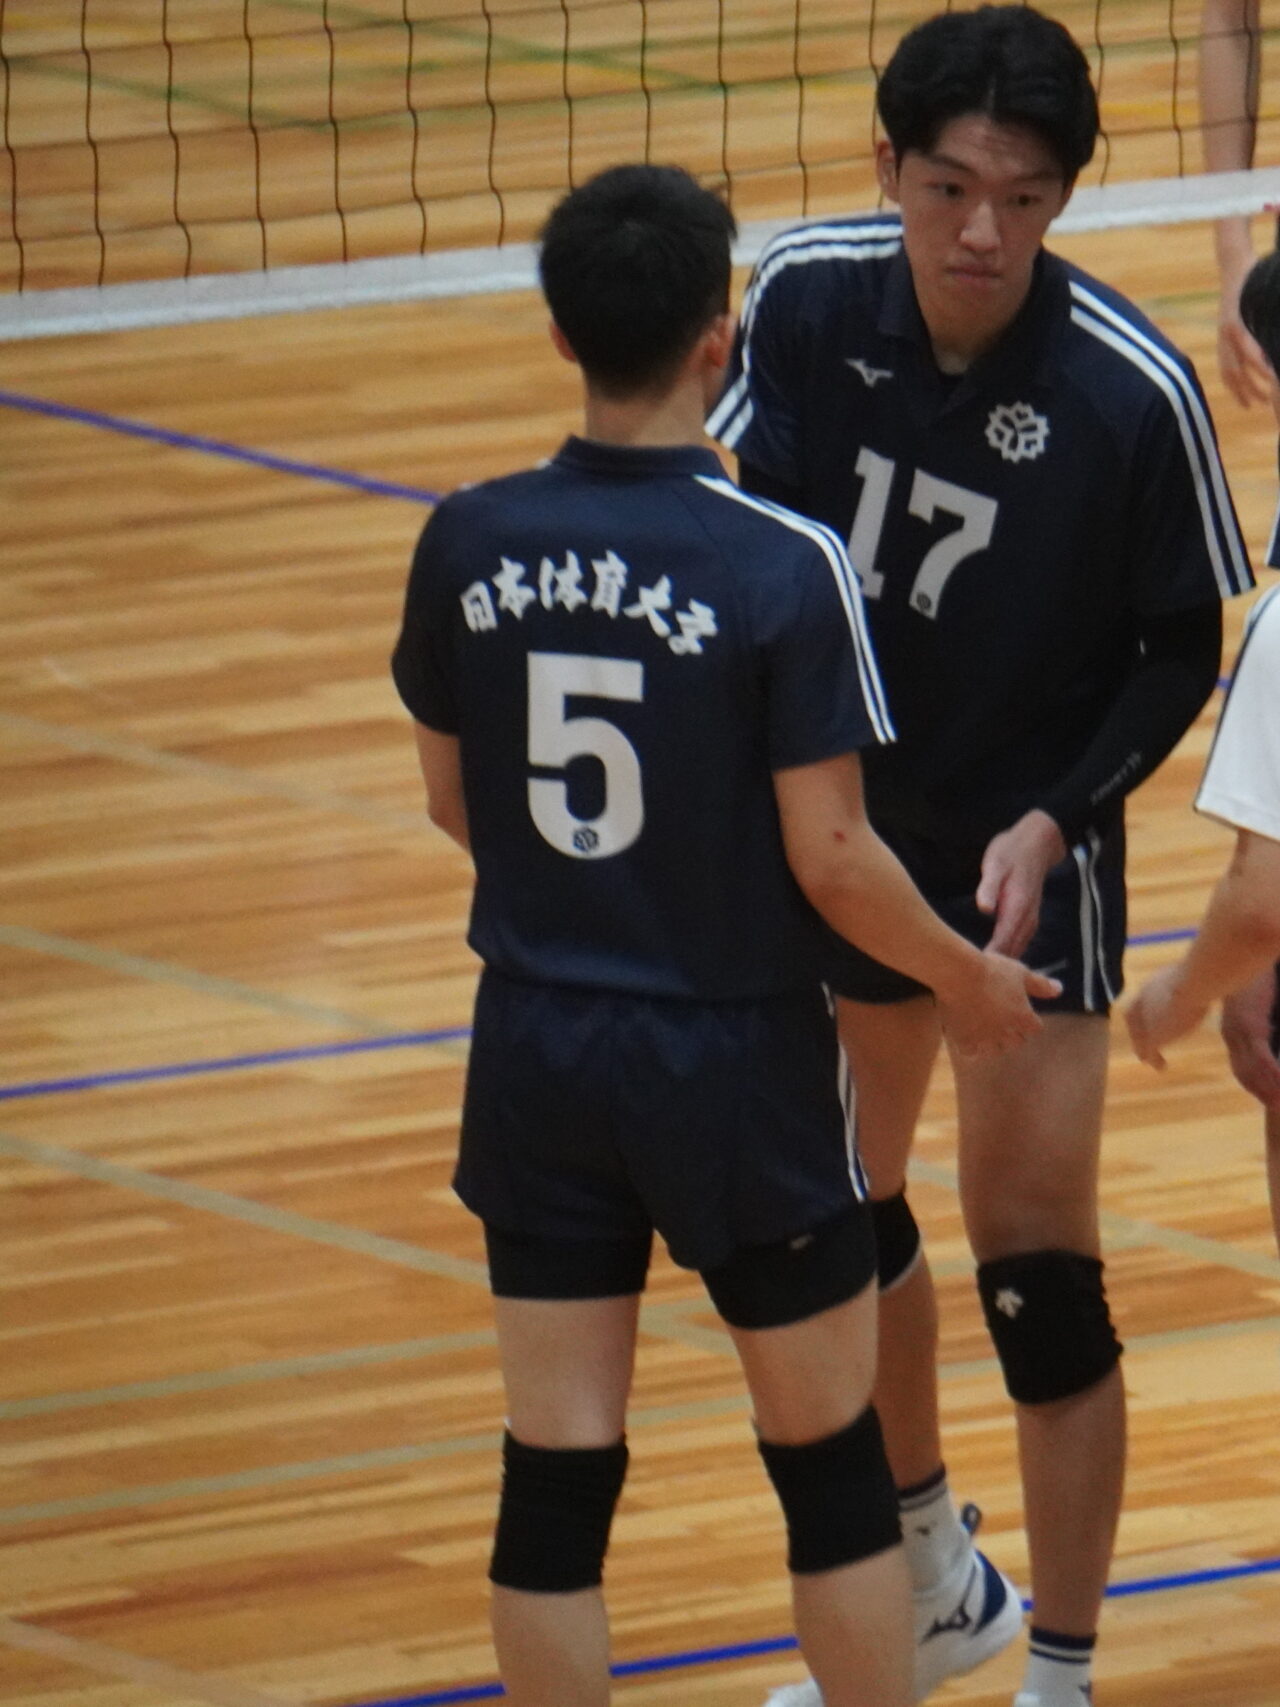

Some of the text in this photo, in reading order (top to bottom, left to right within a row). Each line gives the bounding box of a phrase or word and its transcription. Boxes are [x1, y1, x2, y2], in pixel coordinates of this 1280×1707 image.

[460, 549, 718, 656] 日本体育大学
[846, 446, 999, 620] 17
[527, 651, 645, 860] 5
